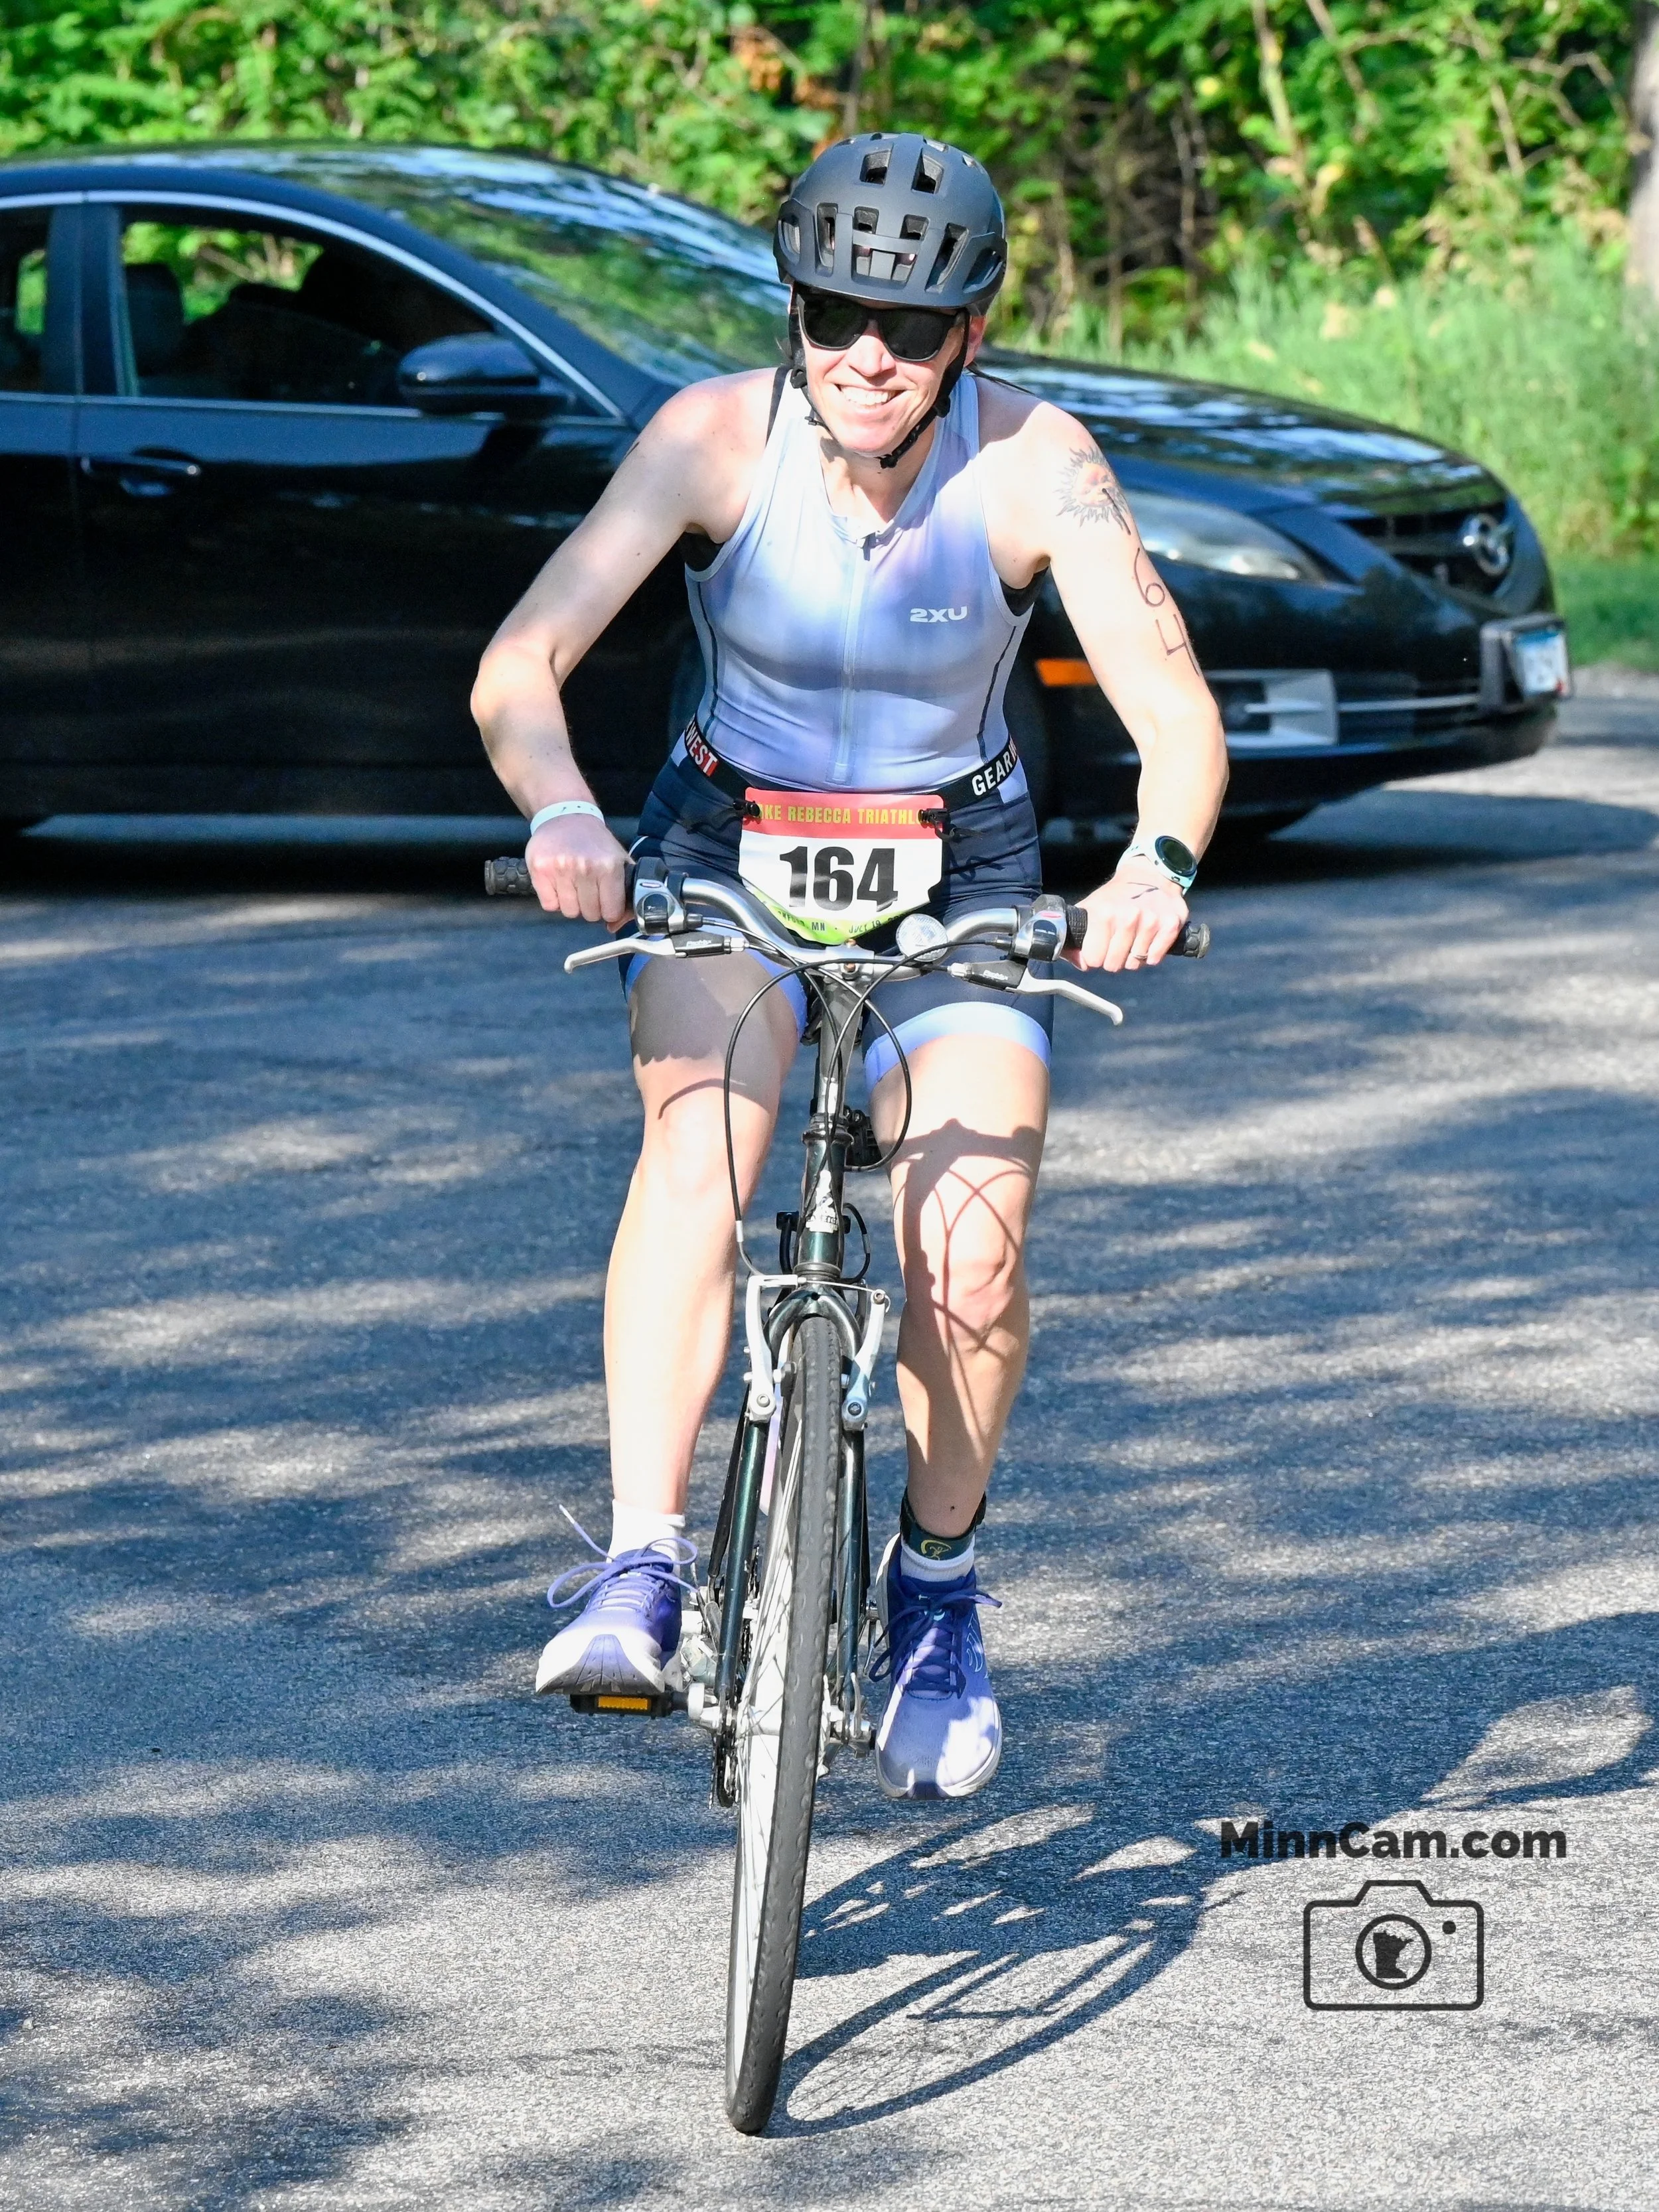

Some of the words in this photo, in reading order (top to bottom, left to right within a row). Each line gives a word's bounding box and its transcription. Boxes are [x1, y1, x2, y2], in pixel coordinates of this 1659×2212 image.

[910, 606, 968, 623] 2XU
[685, 721, 718, 774] WEST
[972, 751, 1013, 796] GEAR
[788, 806, 851, 824] REBECCA
[857, 808, 920, 825] TRIATHL
[780, 846, 899, 912] 164
[812, 922, 826, 932] MN
